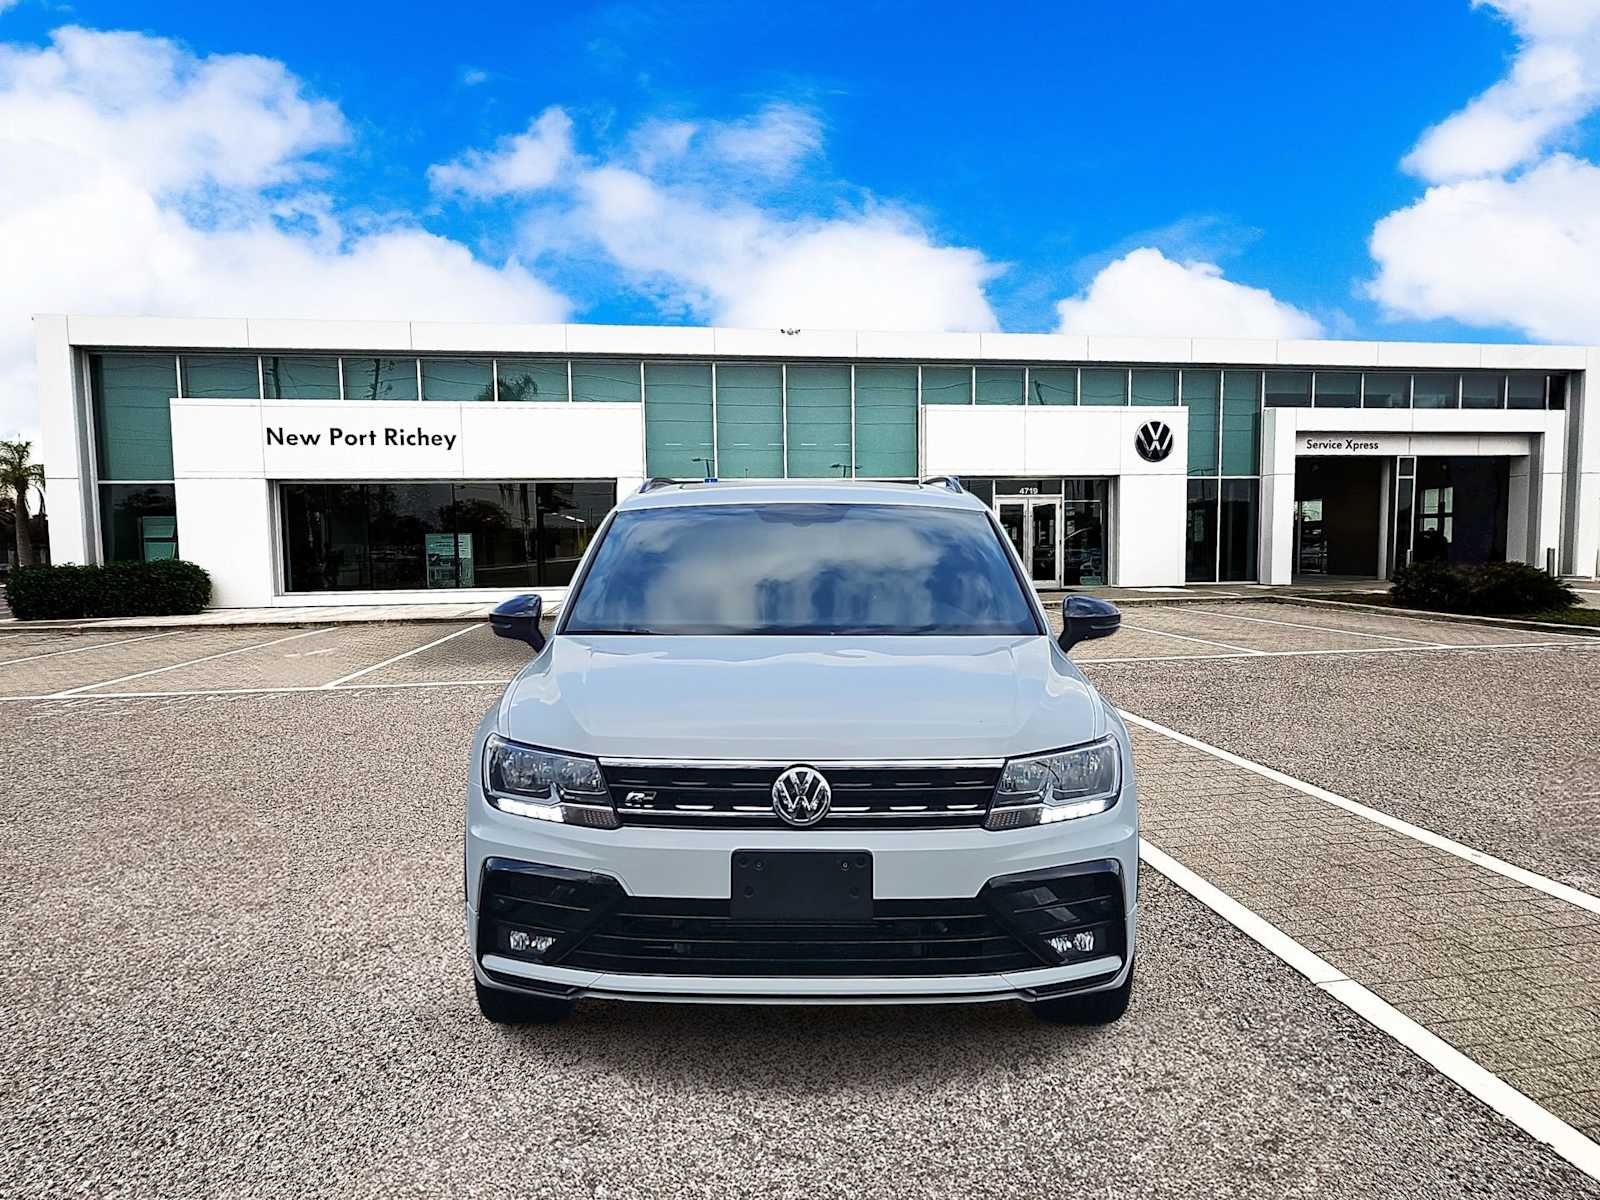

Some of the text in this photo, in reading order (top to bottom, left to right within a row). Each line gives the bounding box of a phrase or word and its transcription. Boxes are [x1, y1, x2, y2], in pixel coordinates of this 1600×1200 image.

[266, 427, 457, 451] New Port Richey
[1306, 439, 1379, 452] Service Xpress
[1019, 487, 1039, 495] 4719
